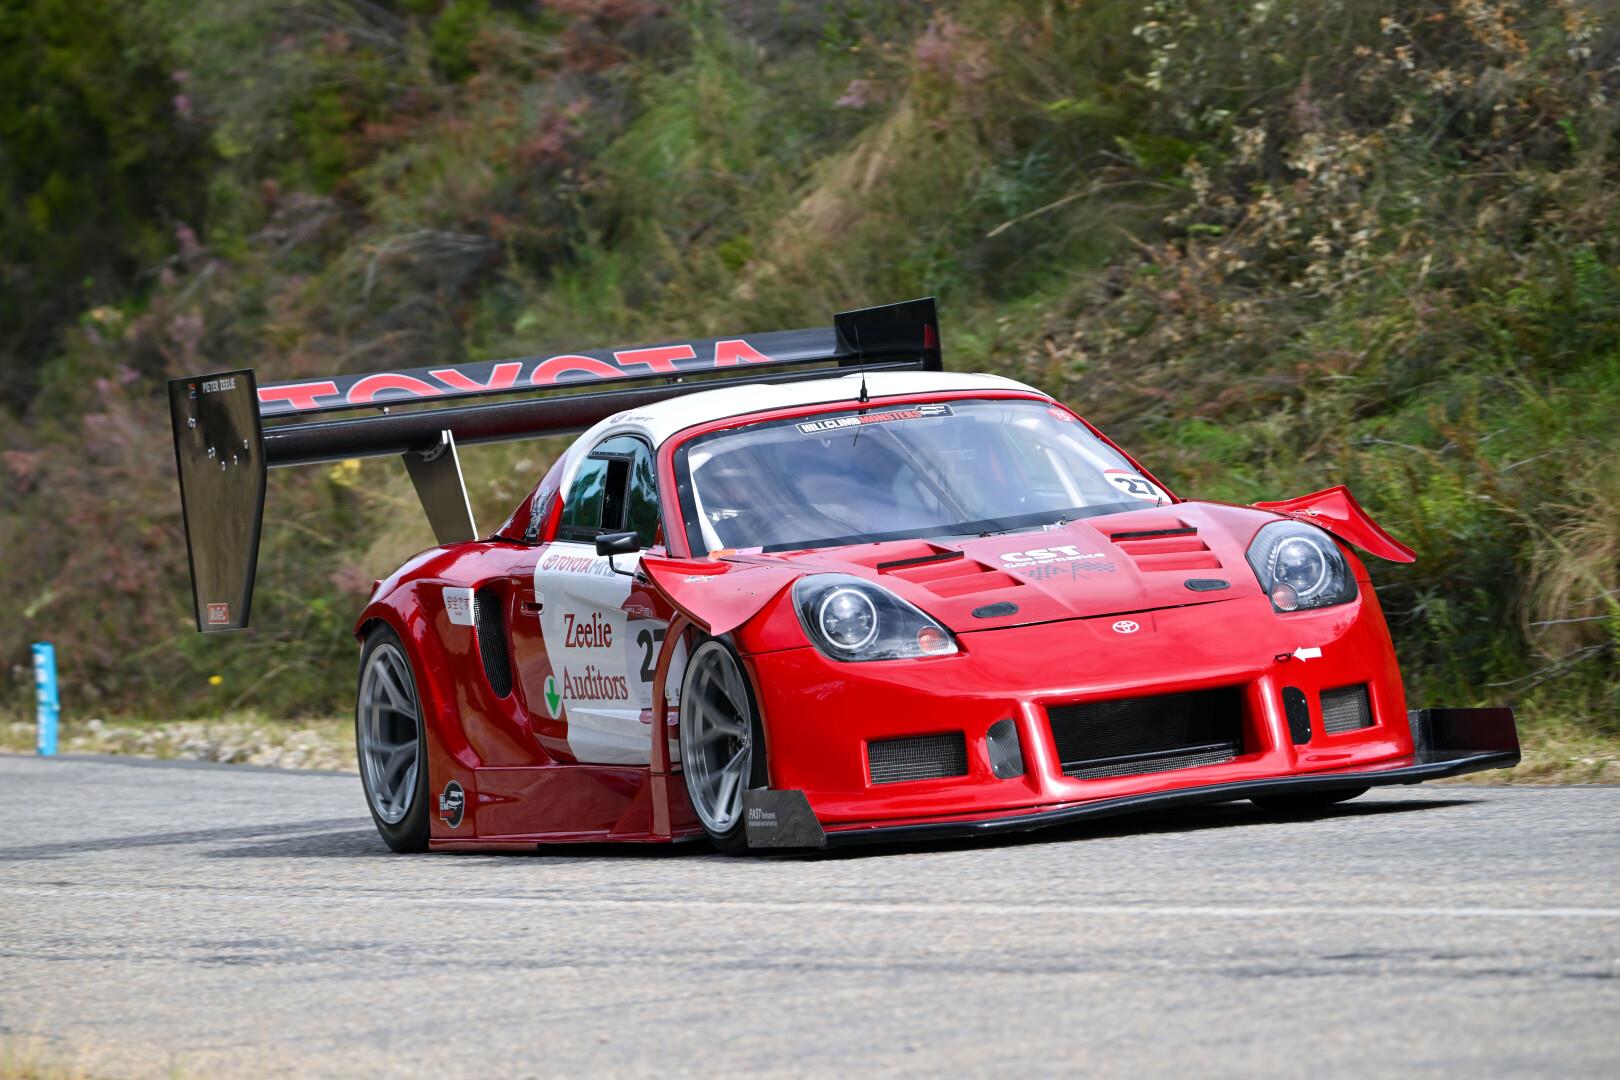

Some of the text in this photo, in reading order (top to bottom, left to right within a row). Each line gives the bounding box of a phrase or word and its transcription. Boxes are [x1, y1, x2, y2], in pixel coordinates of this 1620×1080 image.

[1114, 477, 1157, 495] 27
[1000, 545, 1081, 562] CST
[1003, 553, 1106, 568] Governance
[564, 612, 612, 648] Zeelie
[562, 664, 629, 700] Auditors
